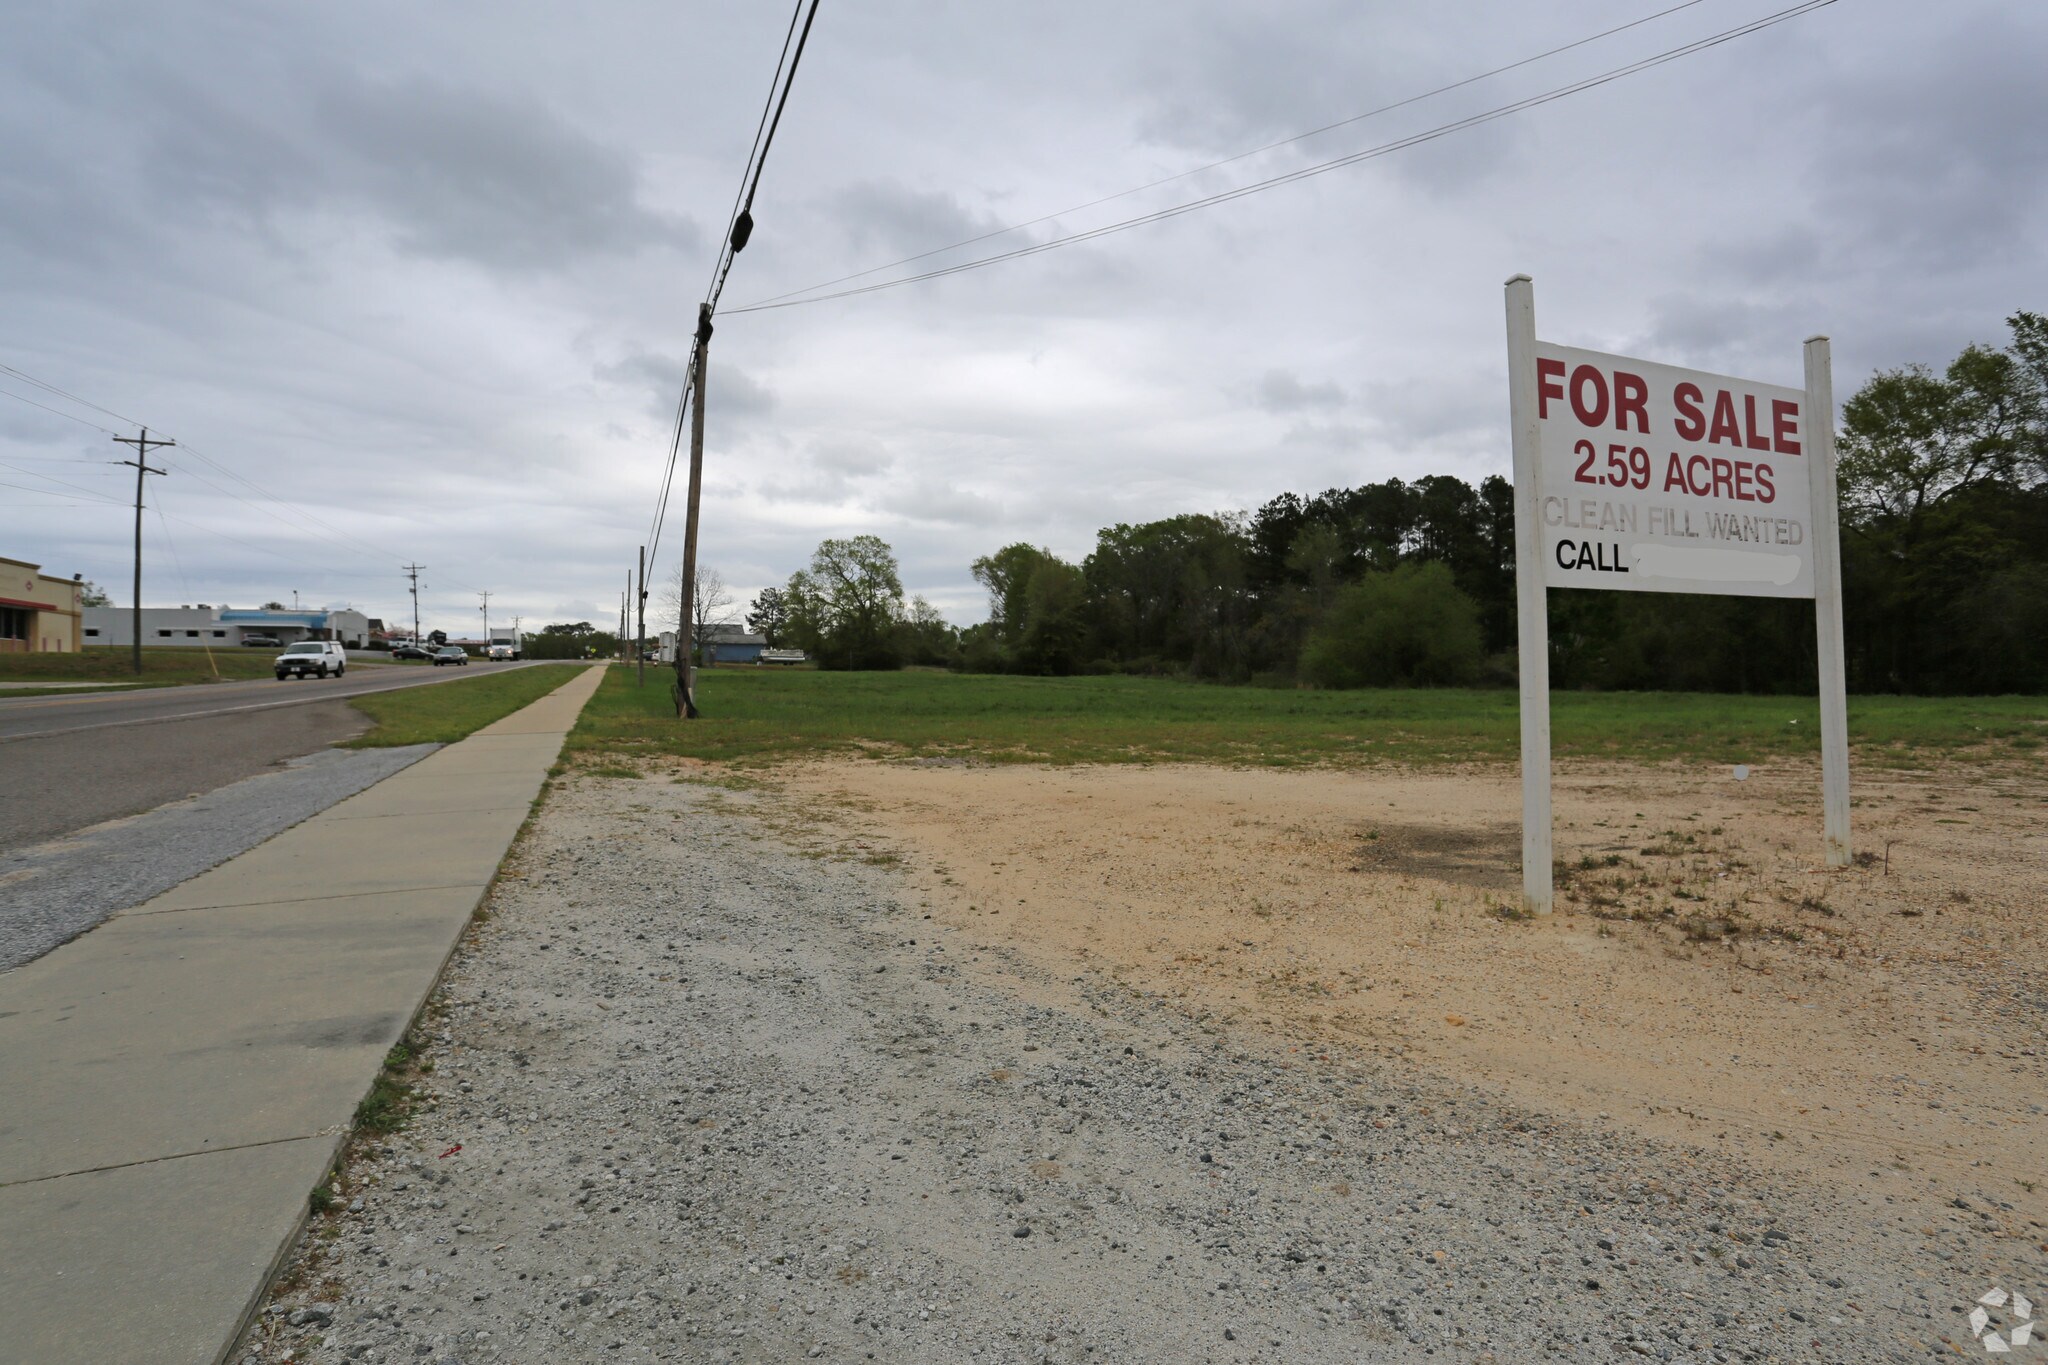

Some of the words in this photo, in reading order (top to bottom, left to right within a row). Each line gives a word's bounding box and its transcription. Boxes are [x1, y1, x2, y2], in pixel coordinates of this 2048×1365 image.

[1537, 357, 1650, 434] FOR
[1673, 382, 1801, 456] SALE
[1573, 439, 1651, 490] 2.59
[1663, 452, 1776, 504] ACRES
[1543, 496, 1638, 533] CLEAN
[1649, 507, 1699, 538] FILL
[1705, 511, 1804, 546] WANTED
[1556, 539, 1629, 573] CALL
